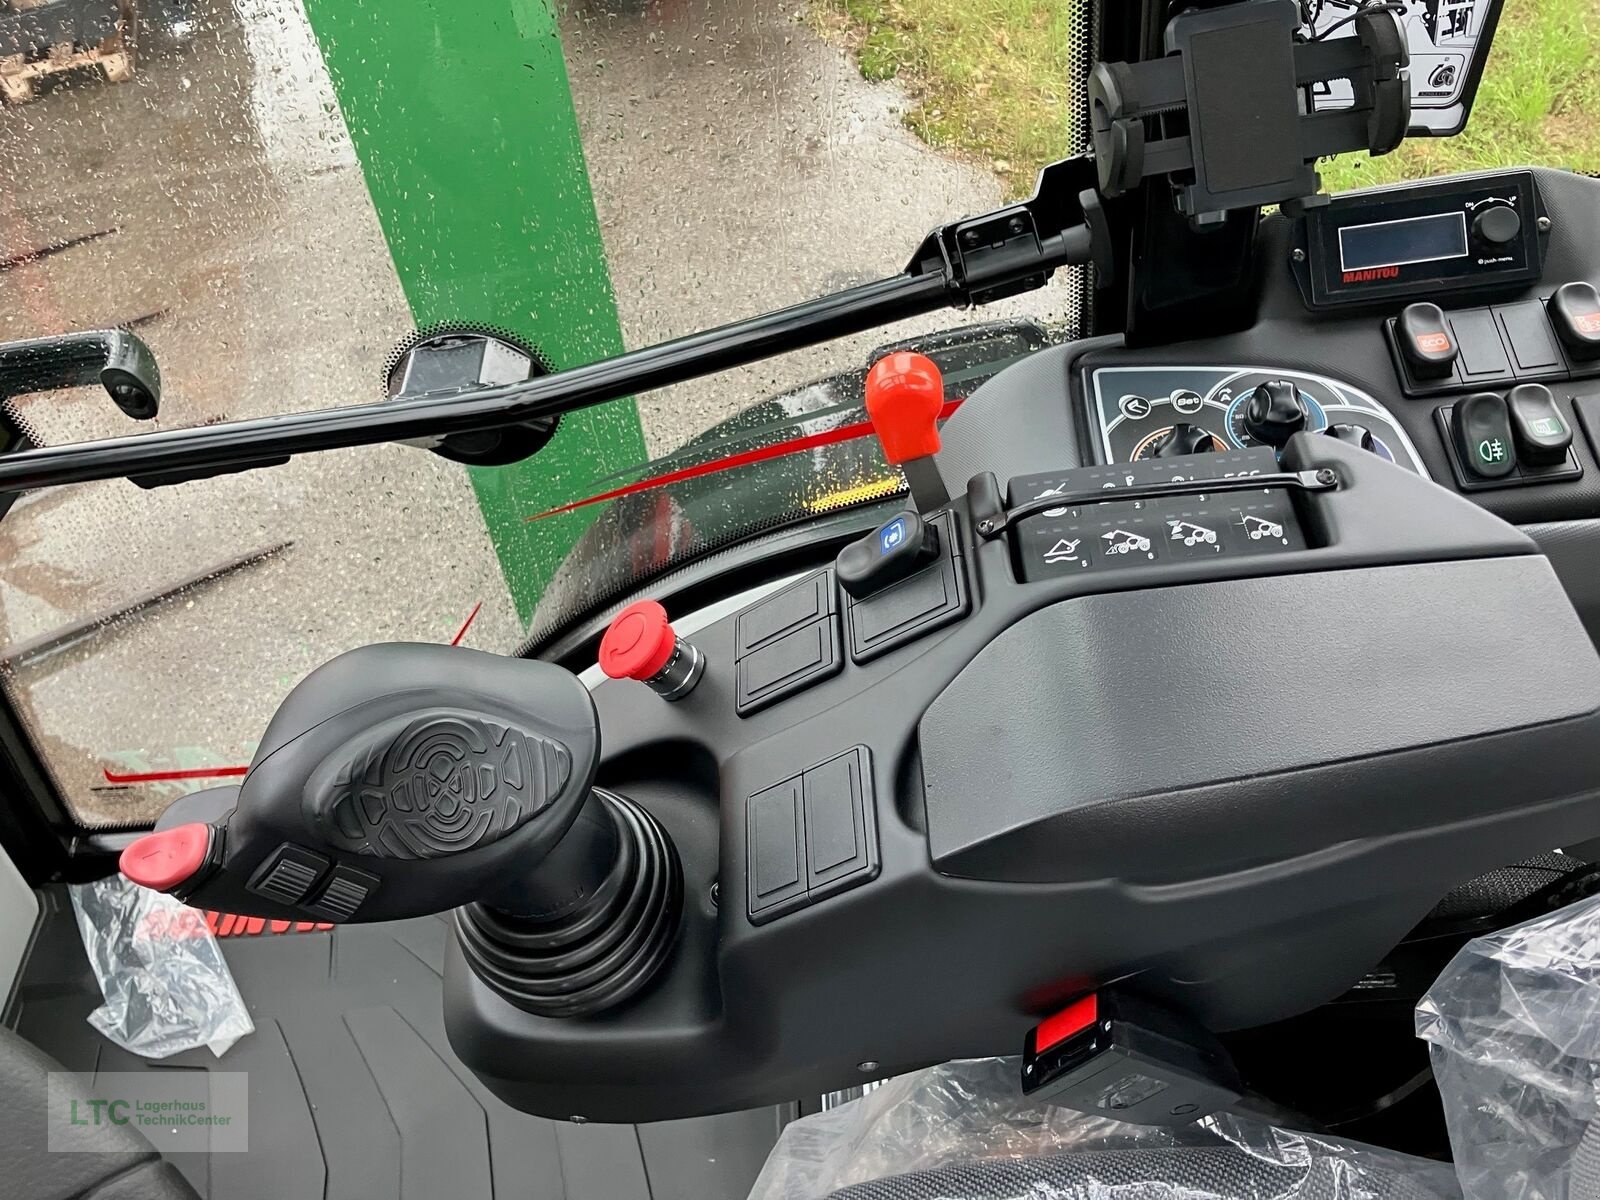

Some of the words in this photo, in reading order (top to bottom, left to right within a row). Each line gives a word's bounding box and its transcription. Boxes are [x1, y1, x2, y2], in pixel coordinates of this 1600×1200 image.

[1343, 266, 1399, 283] MANITOU
[1421, 337, 1446, 348] ECO
[1177, 397, 1200, 406] Set
[1072, 510, 1077, 518] 1
[1081, 560, 1088, 568] 5
